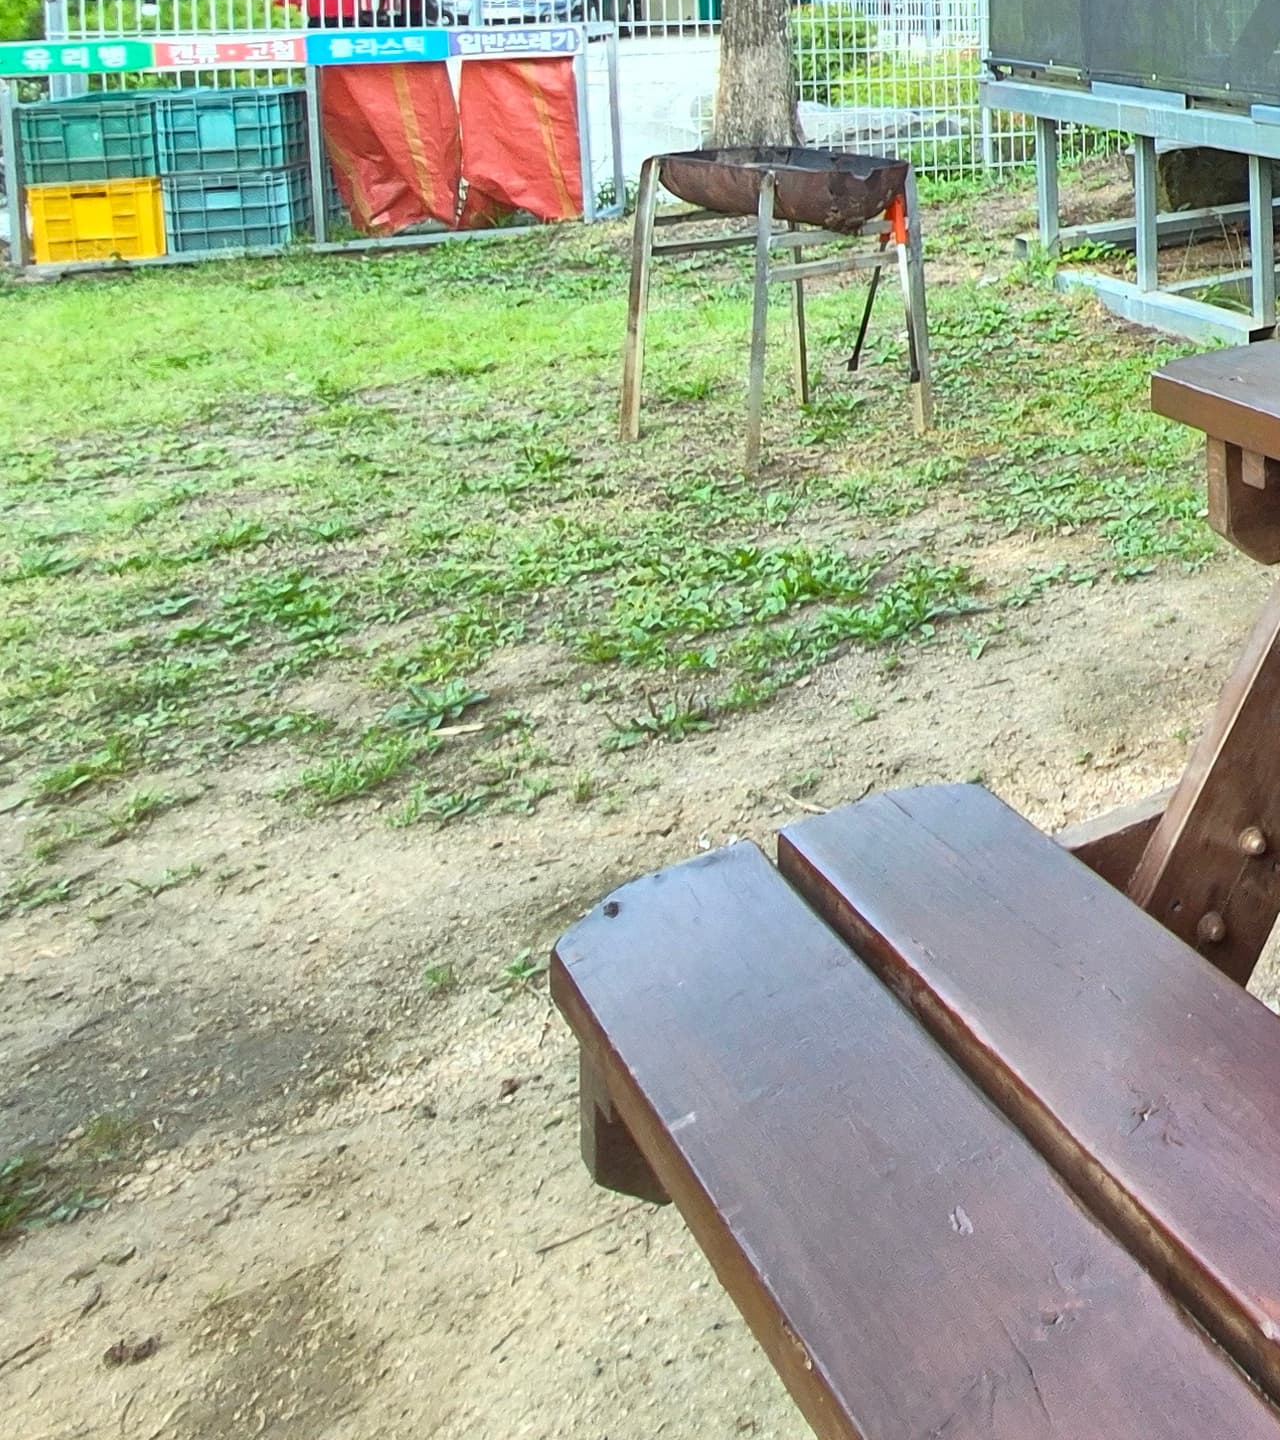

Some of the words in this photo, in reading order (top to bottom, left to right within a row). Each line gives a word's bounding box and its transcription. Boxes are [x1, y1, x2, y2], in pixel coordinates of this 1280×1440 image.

[329, 35, 425, 59] 플라스틱
[457, 29, 575, 54] 일반쓰레기
[21, 45, 128, 71] 유리병
